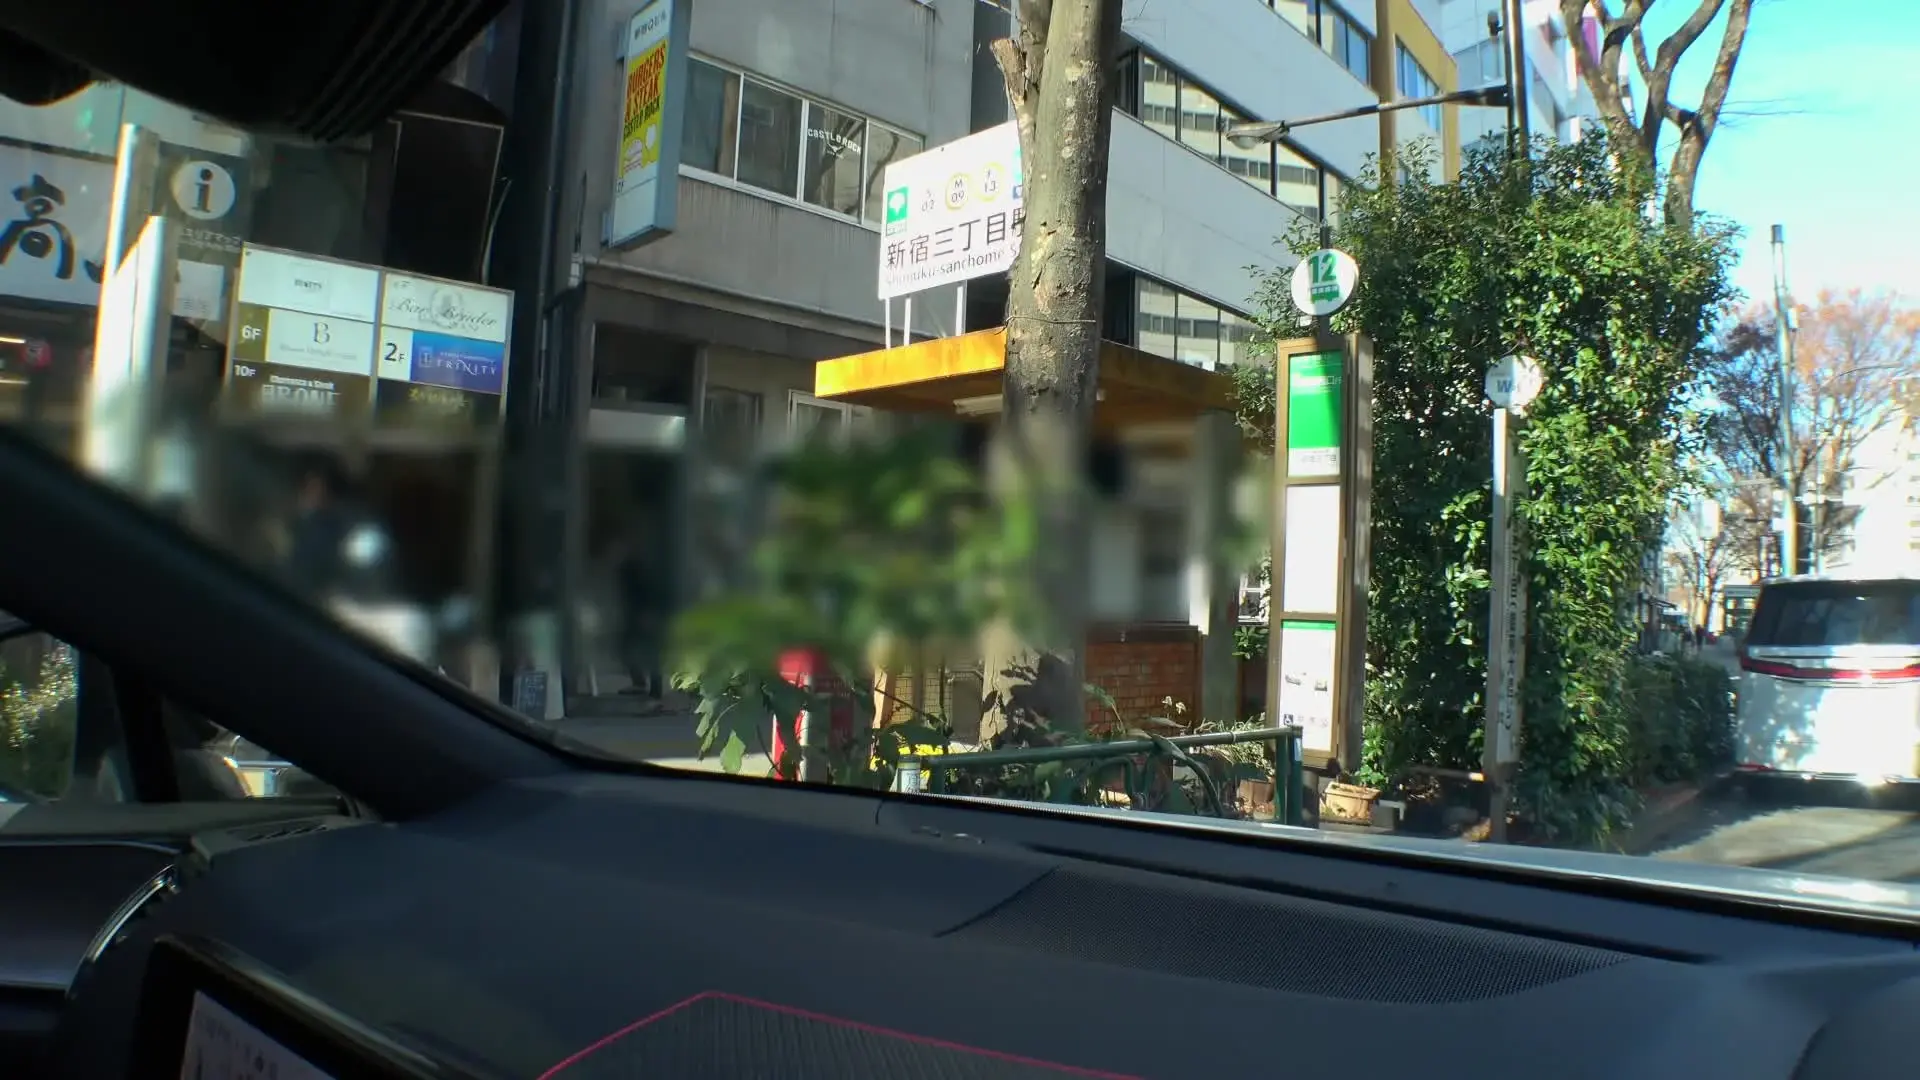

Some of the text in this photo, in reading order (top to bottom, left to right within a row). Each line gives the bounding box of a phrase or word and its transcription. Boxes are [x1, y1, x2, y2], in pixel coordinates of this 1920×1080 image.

[1308, 252, 1337, 283] 12
[242, 325, 261, 341] 6F
[384, 342, 404, 364] 2F
[235, 365, 256, 377] 10F
[437, 359, 497, 376] TRINITY
